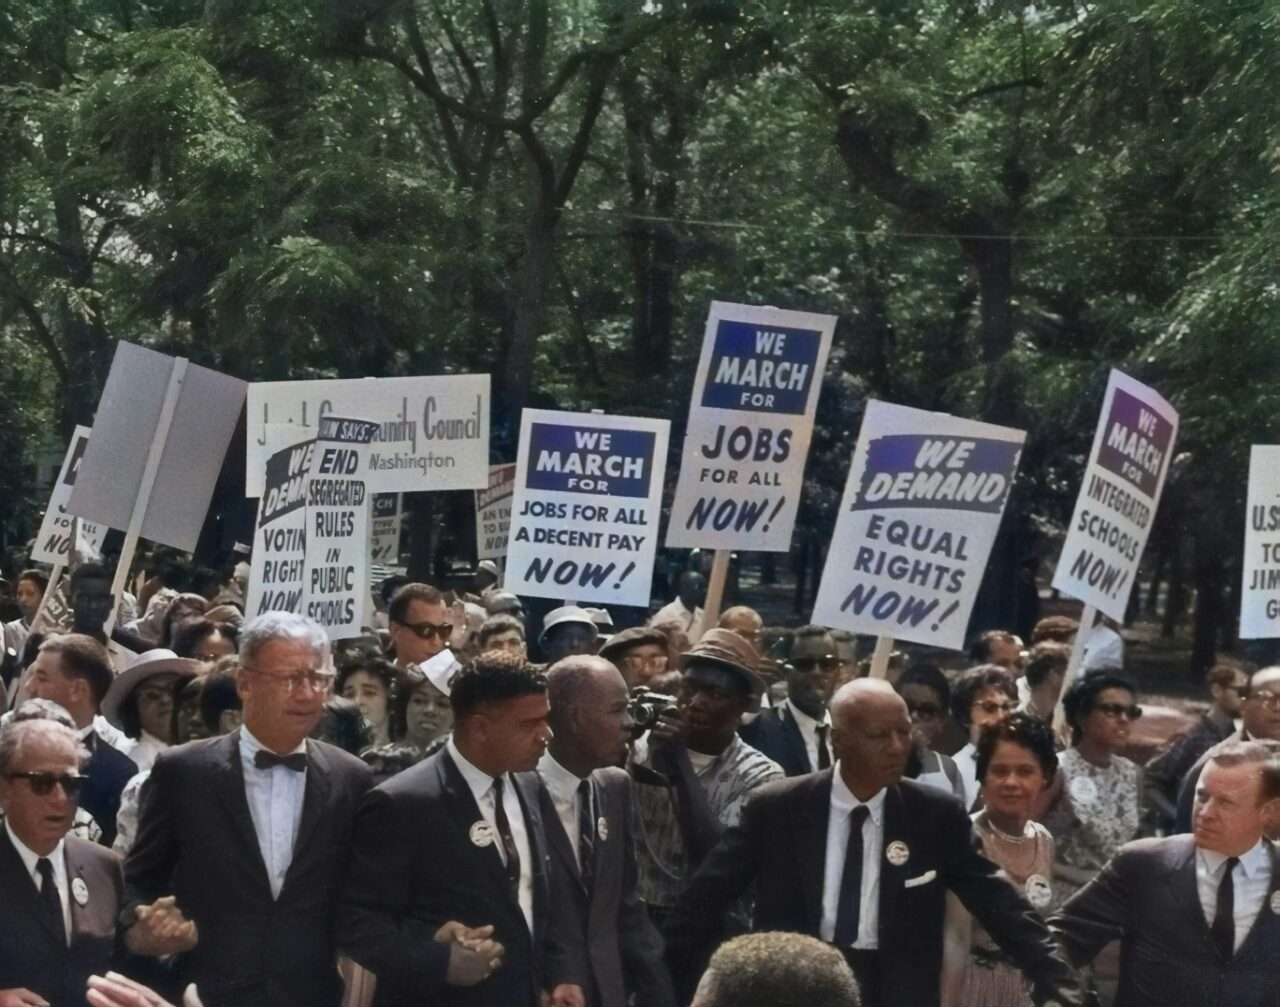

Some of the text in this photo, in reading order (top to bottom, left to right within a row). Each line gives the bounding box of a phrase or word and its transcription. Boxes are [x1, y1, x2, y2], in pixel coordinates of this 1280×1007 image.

[755, 331, 786, 356] WE
[714, 356, 808, 391] MARCH
[740, 392, 775, 408] FOR
[424, 395, 482, 440] Council
[1138, 408, 1159, 438] WE
[575, 431, 611, 451] WE
[701, 425, 793, 463] JOBS
[915, 439, 975, 469] WE
[1107, 423, 1163, 473] MARCH
[319, 449, 358, 474] END
[536, 450, 644, 479] MARCH
[1122, 462, 1143, 483] FOR
[568, 478, 608, 492] FOR
[700, 468, 781, 486] FOR ALL
[865, 471, 1006, 502] DEMAND
[265, 473, 308, 517] DEMA
[309, 479, 365, 506] SEGREGATED
[1087, 474, 1150, 528] INTEGRATED
[316, 511, 354, 537] RULES
[520, 501, 647, 525] JOBS FOR ALL
[686, 496, 786, 533] NOW!
[264, 528, 306, 552] VOTIN
[515, 526, 530, 542] A
[534, 528, 603, 549] DECENT
[609, 534, 645, 552] PAY
[865, 515, 969, 562] EQUAL
[1078, 509, 1139, 560] SCHOOLS
[326, 548, 341, 563] IN
[853, 546, 965, 594] RIGHTS
[263, 559, 304, 584] RIGHT
[312, 566, 354, 594] PUBLIC
[524, 557, 635, 589] NOW!
[1070, 549, 1129, 600] NOW!
[308, 598, 354, 626] SCHOOLS
[840, 583, 961, 632] NOW!
